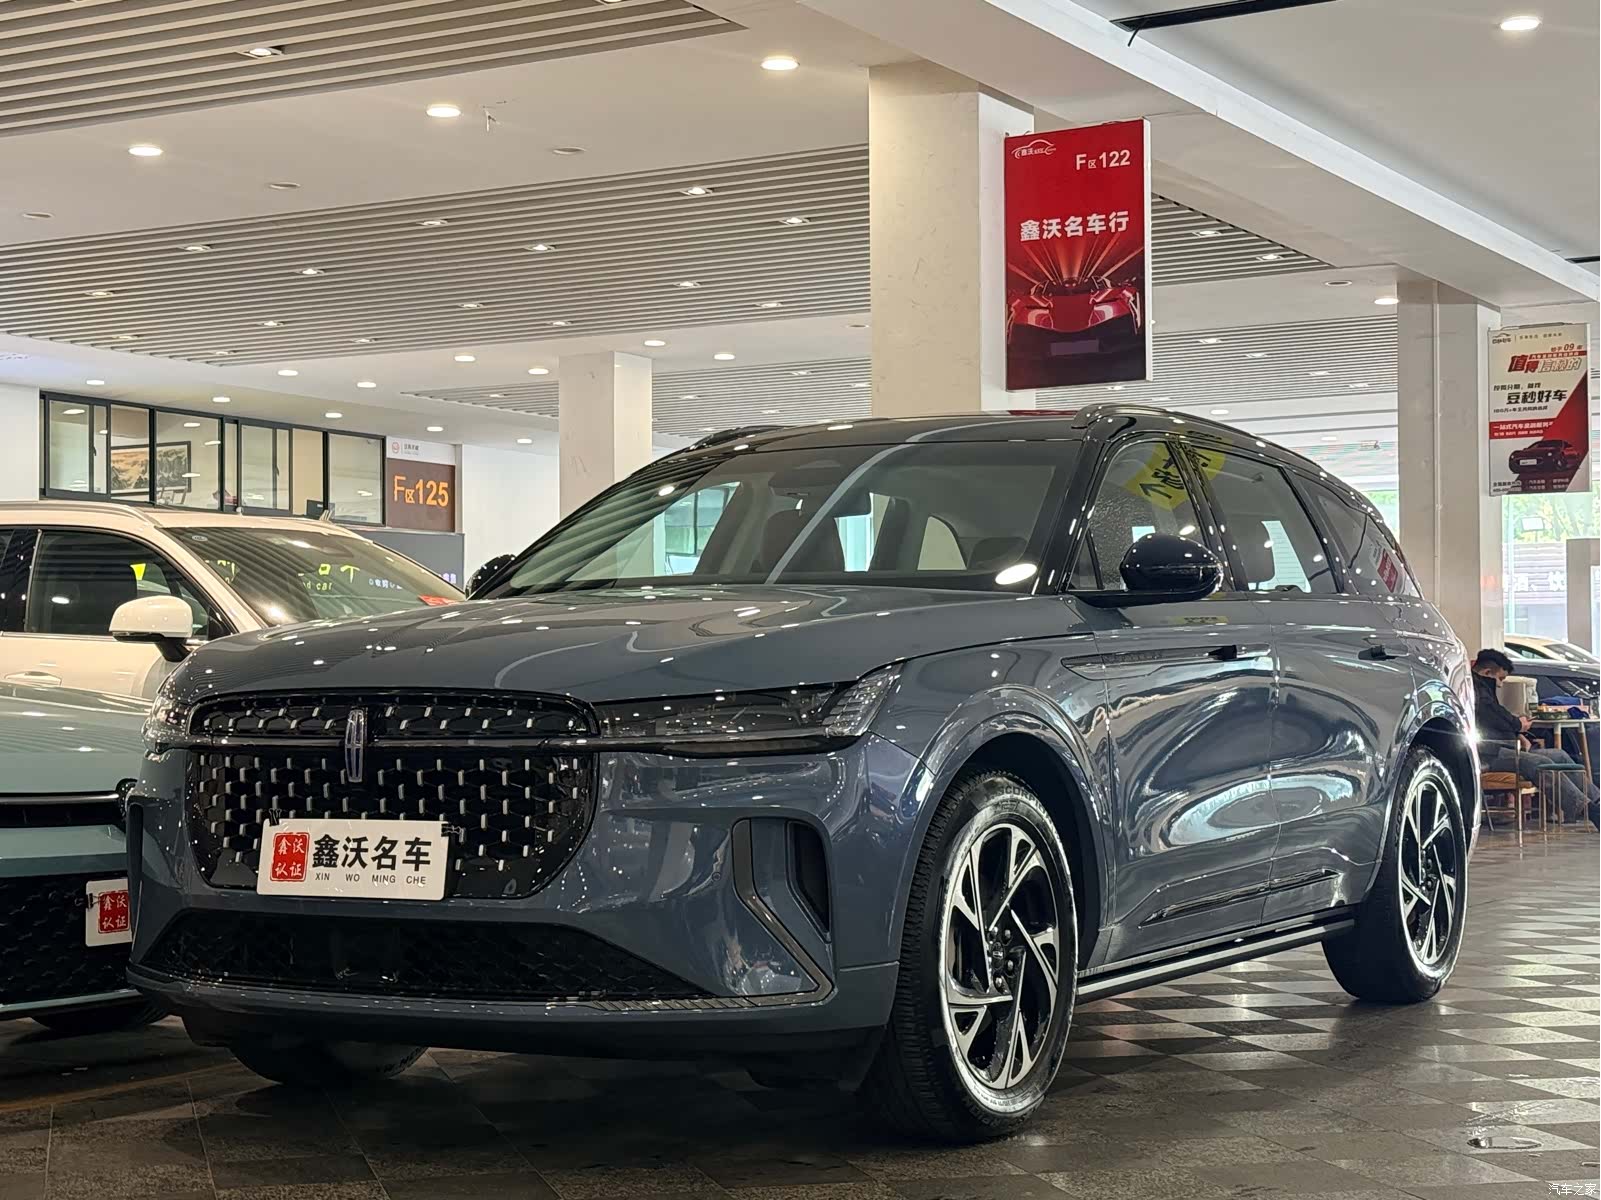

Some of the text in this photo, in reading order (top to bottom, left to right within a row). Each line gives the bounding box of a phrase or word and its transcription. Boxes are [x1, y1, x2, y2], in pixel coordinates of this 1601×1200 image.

[1075, 150, 1131, 170] F区122
[1020, 210, 1129, 242] 鑫沃名车行
[1506, 390, 1568, 405] 豆秒好车
[394, 475, 449, 507] F区125
[278, 837, 305, 856] 鑫沃
[312, 834, 432, 871] 鑫沃名车
[275, 862, 303, 878] 认证
[315, 873, 427, 885] XIN WO MING CHE
[102, 915, 127, 929] 认证
